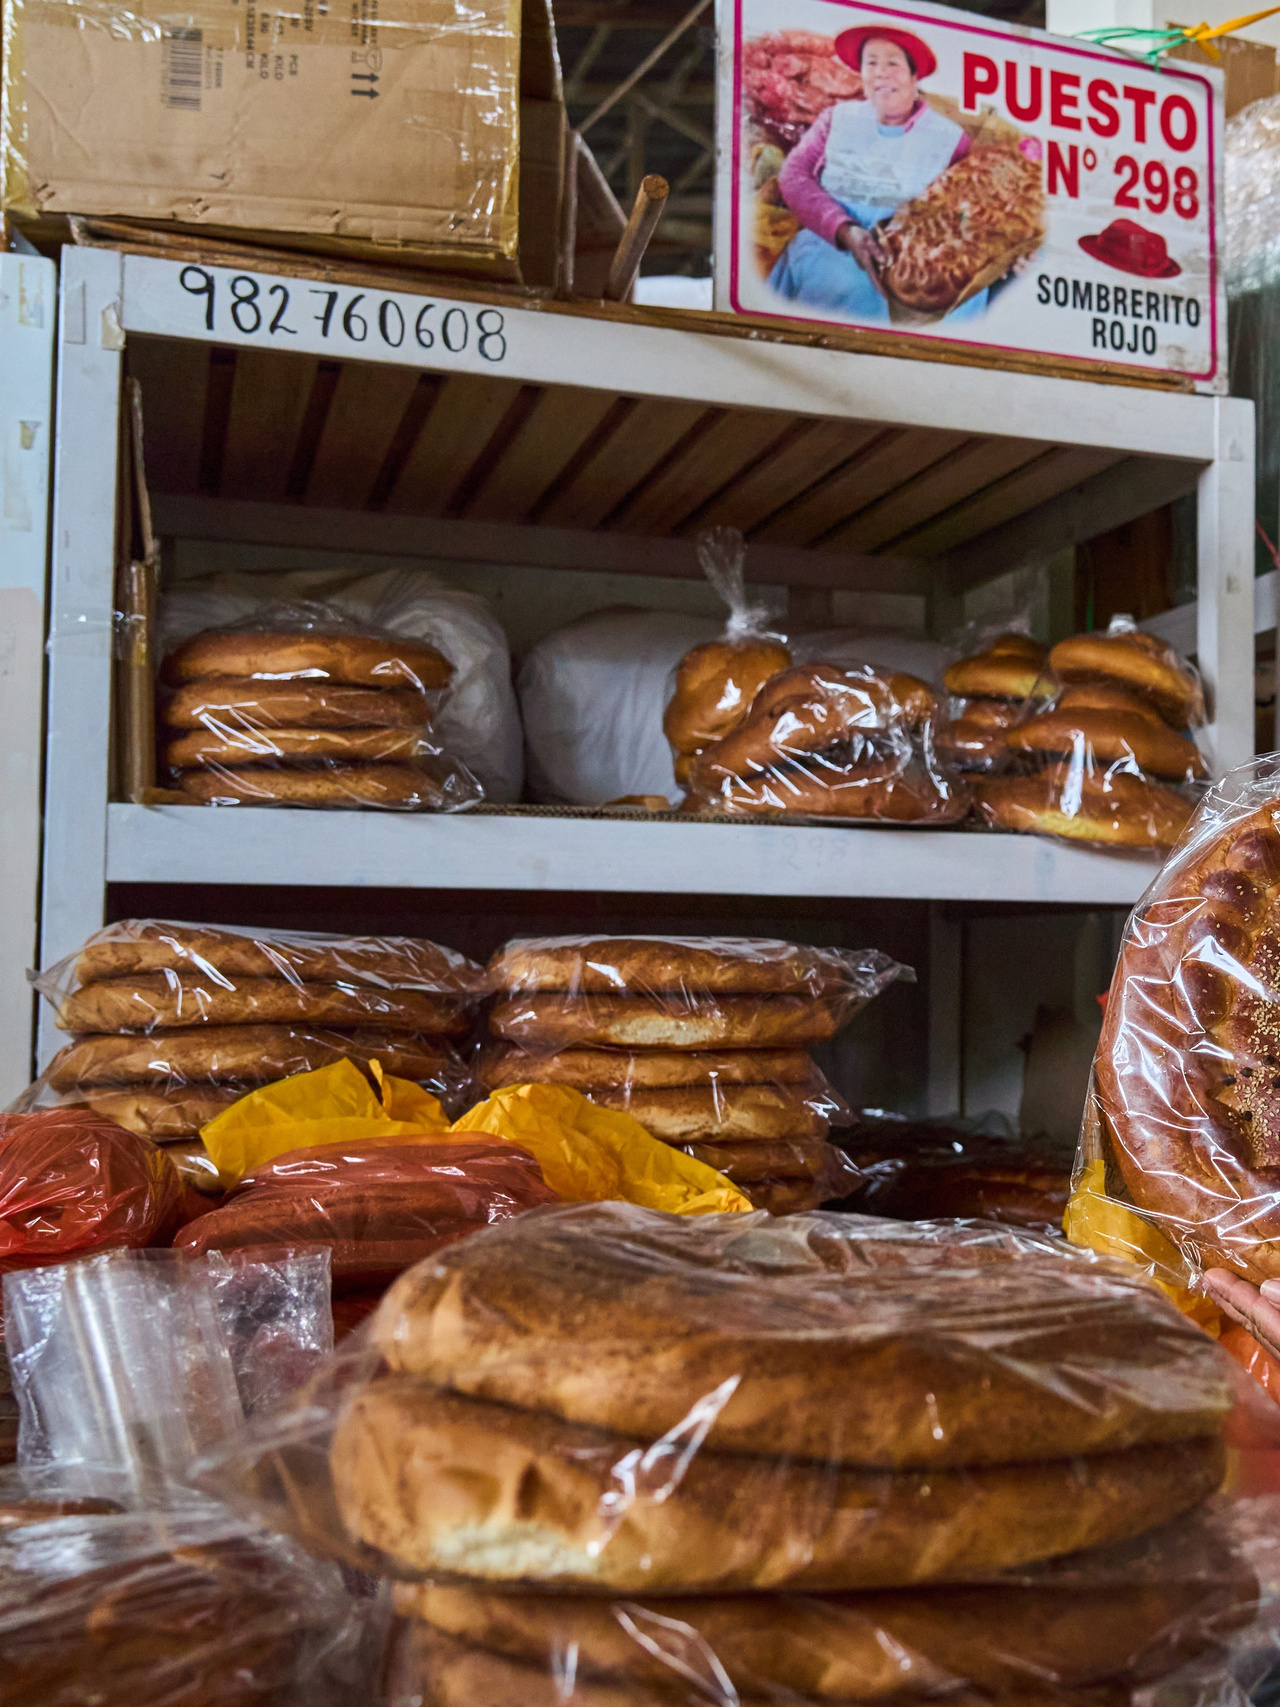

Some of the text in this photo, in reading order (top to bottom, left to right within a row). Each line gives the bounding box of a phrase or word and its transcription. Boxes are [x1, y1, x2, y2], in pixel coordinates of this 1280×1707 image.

[962, 52, 1198, 153] PUESTO
[1047, 140, 1199, 220] N° 298
[1036, 275, 1201, 328] SOMBRERITO
[1092, 318, 1157, 356] ROJO
